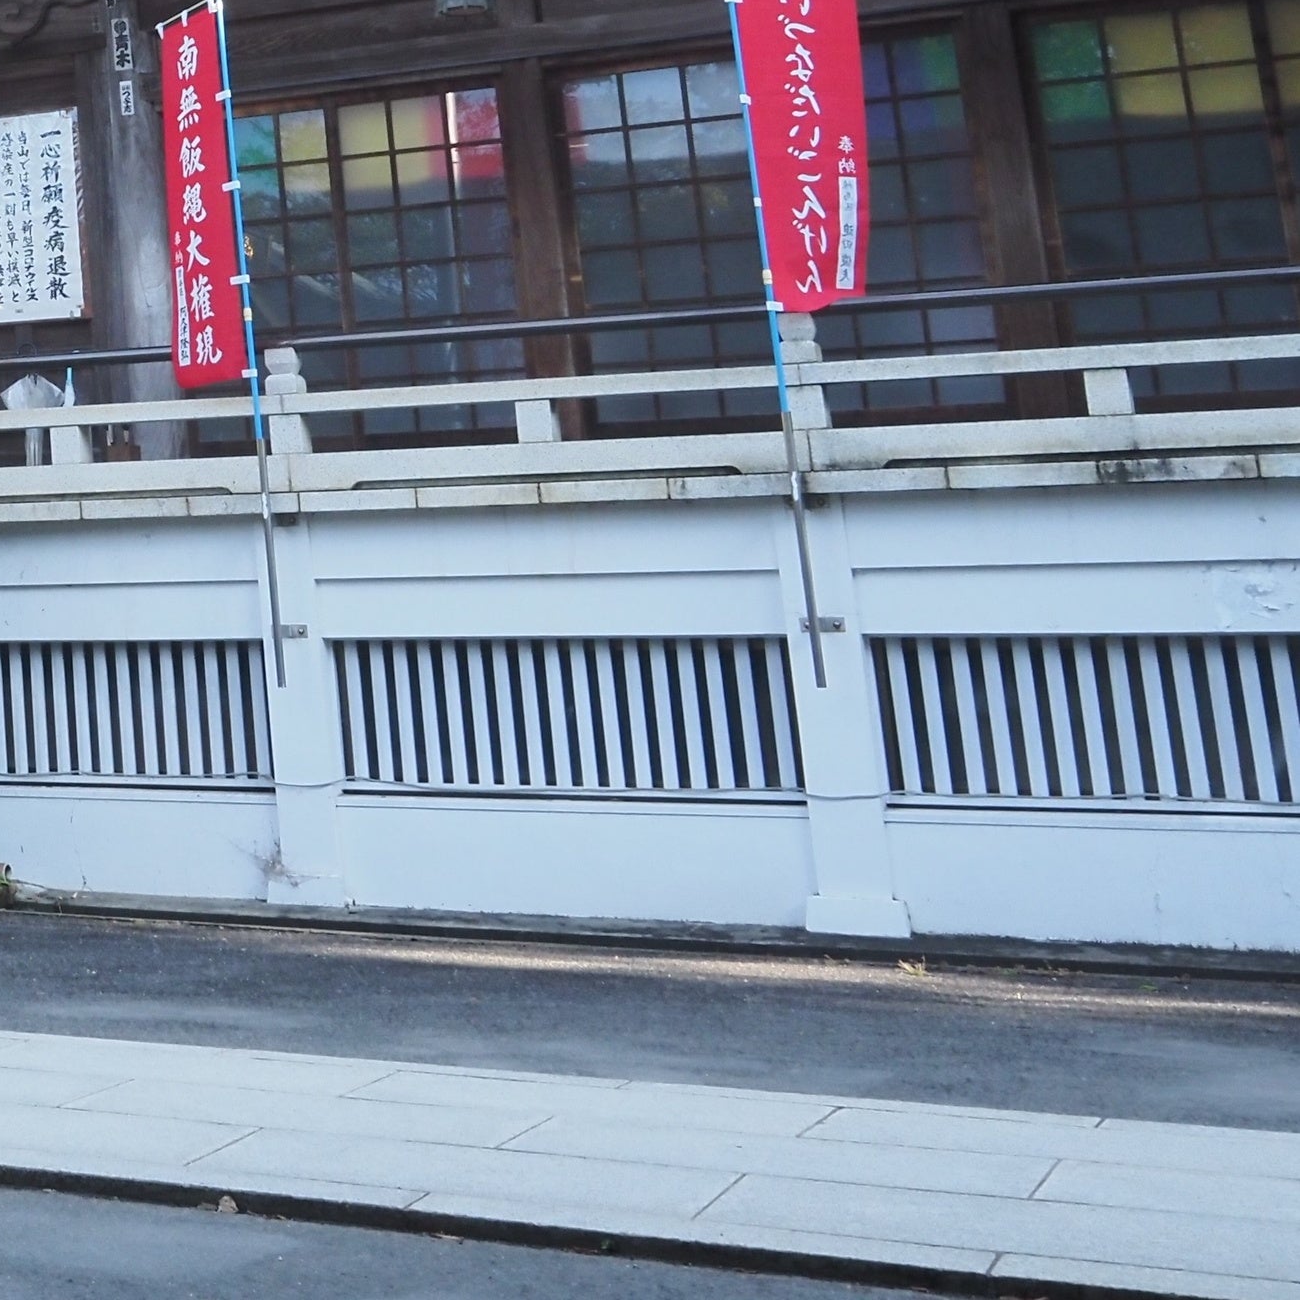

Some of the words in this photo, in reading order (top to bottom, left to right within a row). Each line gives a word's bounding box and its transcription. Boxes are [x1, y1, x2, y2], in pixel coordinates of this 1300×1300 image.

[40, 129, 71, 300] 一心祈願疫病退散
[176, 35, 222, 366] 南無飯縄大権現
